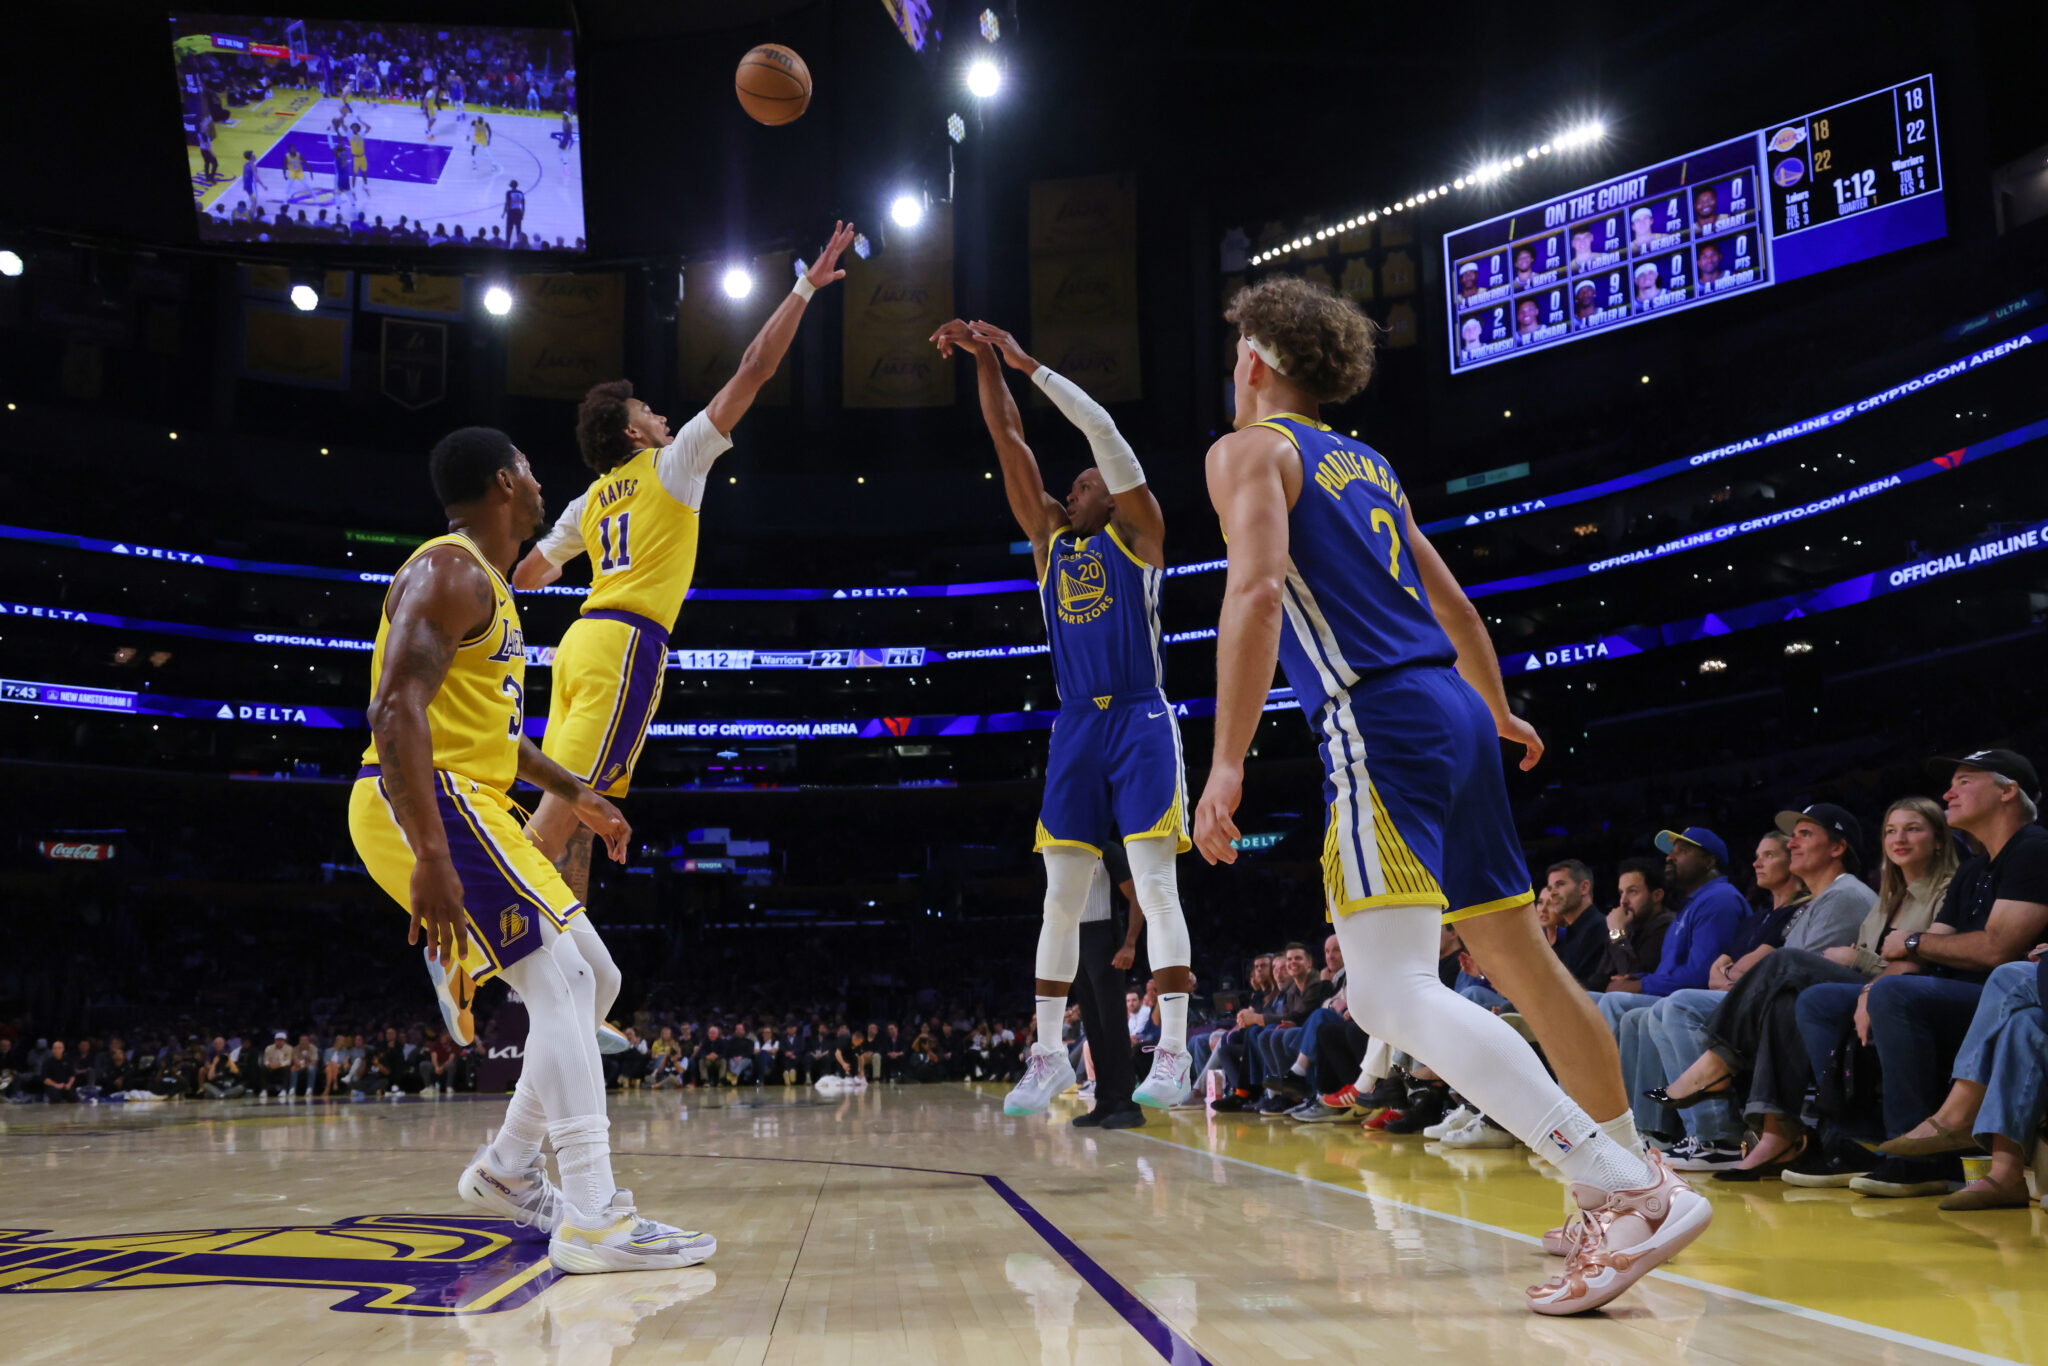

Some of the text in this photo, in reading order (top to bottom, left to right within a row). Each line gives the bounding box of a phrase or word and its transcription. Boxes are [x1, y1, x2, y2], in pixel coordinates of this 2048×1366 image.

[1904, 87, 1923, 112] 18
[1813, 119, 1829, 141] 18
[1906, 119, 1926, 144] 22
[1814, 149, 1832, 173] 22
[1892, 155, 1924, 172] Warriors
[1917, 166, 1924, 178] 6
[1732, 178, 1743, 199] 0
[1833, 169, 1877, 204] 1:12
[1900, 179, 1925, 196] FLS 4
[1545, 175, 1648, 228] ON THE COURT
[1731, 198, 1746, 212] PTS
[1786, 191, 1809, 204] Lakers
[1802, 201, 1808, 212] 6
[1838, 197, 1868, 216] QUARTER
[1667, 198, 1678, 218] 4
[1606, 218, 1616, 238] 0
[1666, 218, 1681, 232] PTS
[1715, 212, 1747, 233] SMART
[1786, 214, 1810, 230] FLS 3
[1547, 237, 1557, 257] 0
[1605, 238, 1619, 251] PTS
[1651, 232, 1681, 250] REAVES
[1736, 235, 1747, 256] 0
[1491, 255, 1500, 274] 0
[1546, 256, 1560, 270] PTS
[1671, 254, 1682, 275] 0
[1734, 256, 1751, 270] PTS
[1489, 273, 1503, 287] PTS
[1609, 273, 1620, 294] 9
[1670, 275, 1686, 289] PTS
[1715, 269, 1753, 290] HORFORD
[1551, 290, 1560, 311] 0
[1608, 293, 1623, 307] PTS
[1653, 289, 1686, 309] SANTOS
[1494, 307, 1503, 327] 2
[1550, 310, 1563, 323] PTS
[1588, 308, 1617, 326] BUTLER
[1995, 299, 2029, 319] ULTRA
[1493, 326, 1506, 340] PTS
[1533, 322, 1567, 342] RICHARD
[1689, 335, 2032, 466] OFFICIAL AIRLINE OF CRYPTO.COM ARENA
[598, 479, 638, 508] HAYES
[1484, 499, 1546, 520] DELTA
[1588, 475, 1901, 573] OFFICIAL AIRLINE OF CRYPTO.COM ARENA
[599, 511, 632, 576] 11
[135, 546, 204, 564] DELTA
[1890, 552, 1966, 586] OFFICIAL
[1968, 530, 2038, 565] AIRLINE
[1078, 562, 1100, 581] 20
[1177, 560, 1228, 575] CRYPTO
[852, 588, 908, 597] DELTA
[14, 604, 88, 622] DELTA
[1057, 595, 1114, 624] WARRIORS
[253, 633, 376, 651] OFFICIAL AIRLIN
[1172, 629, 1217, 642] ARENA
[688, 652, 748, 668] 1:12 1
[760, 655, 803, 665] Warriors
[821, 653, 842, 666] 22
[894, 655, 901, 664] 4
[911, 655, 918, 664] 6
[947, 645, 1051, 659] OFFICIAL AIRLIN
[1545, 642, 1609, 666] DELTA
[6, 685, 37, 699] 7:43
[60, 691, 78, 703] NEW
[239, 706, 306, 722] DELTA
[699, 725, 717, 736] OF
[720, 724, 810, 737] CRYPTO.COM
[812, 723, 858, 735] ARENA
[1242, 836, 1283, 848] DELT
